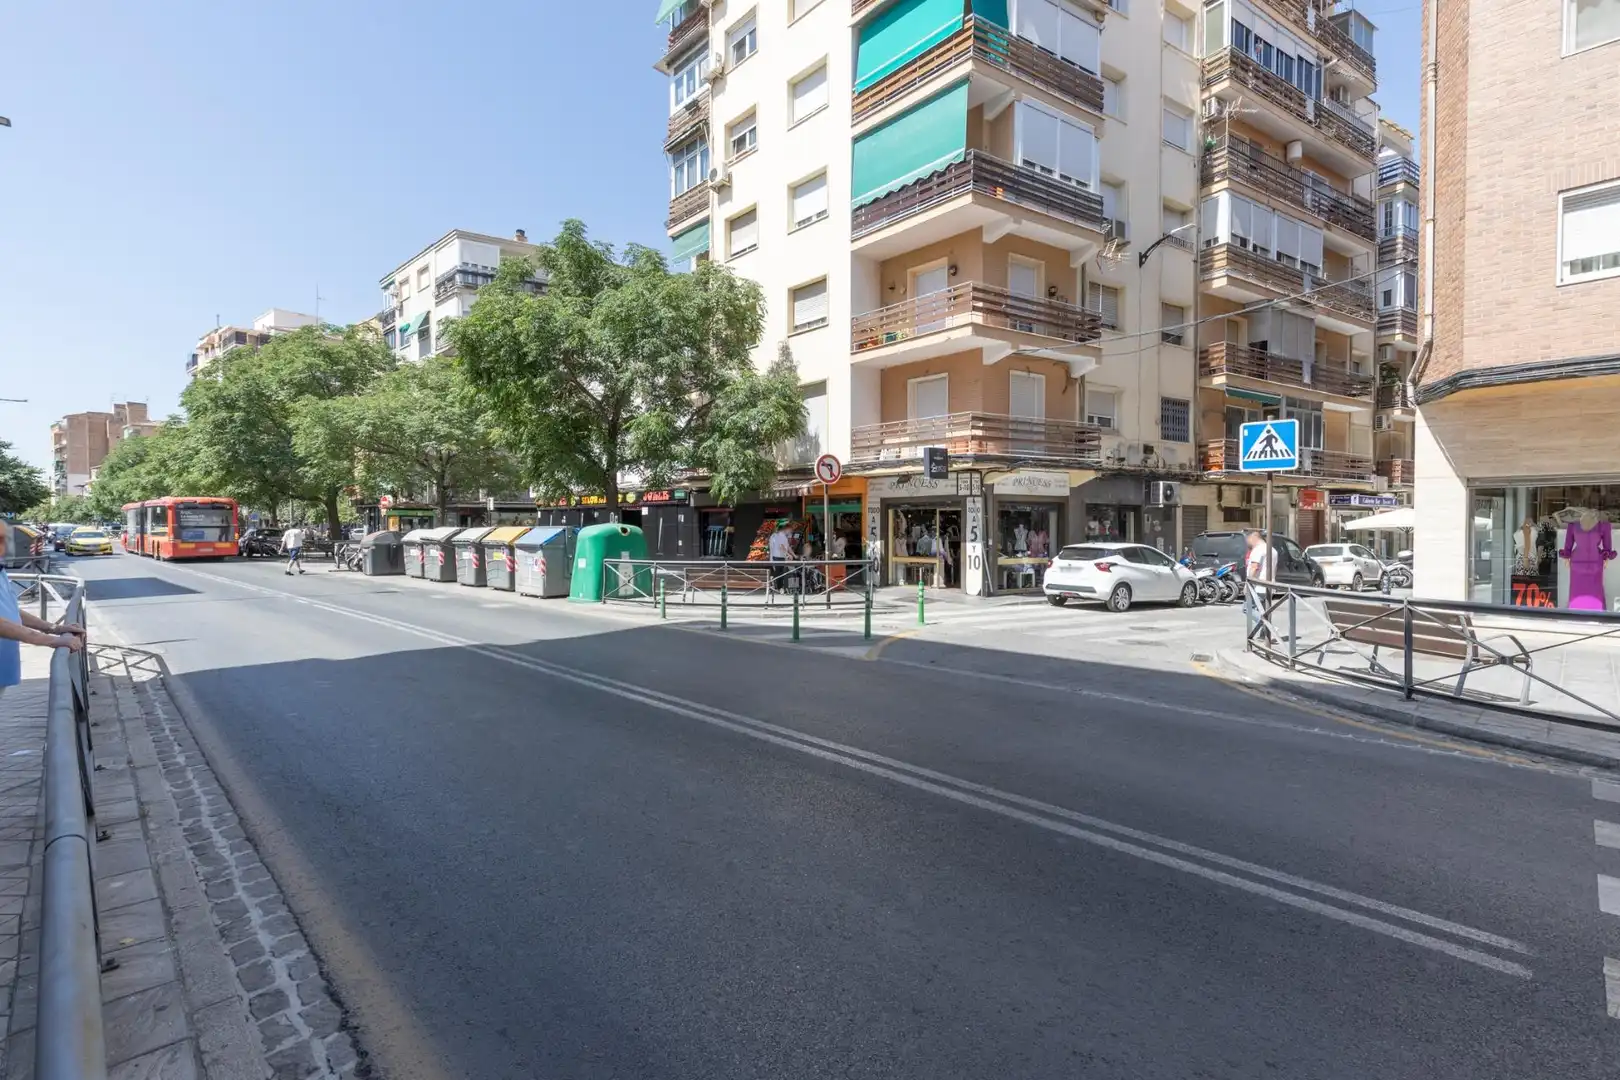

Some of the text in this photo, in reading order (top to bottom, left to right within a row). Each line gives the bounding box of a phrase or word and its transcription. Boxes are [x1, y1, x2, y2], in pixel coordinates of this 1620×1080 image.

[1012, 476, 1052, 488] PRINCESS
[970, 525, 978, 543] 5
[967, 554, 981, 571] 10
[1511, 583, 1556, 608] 70%
